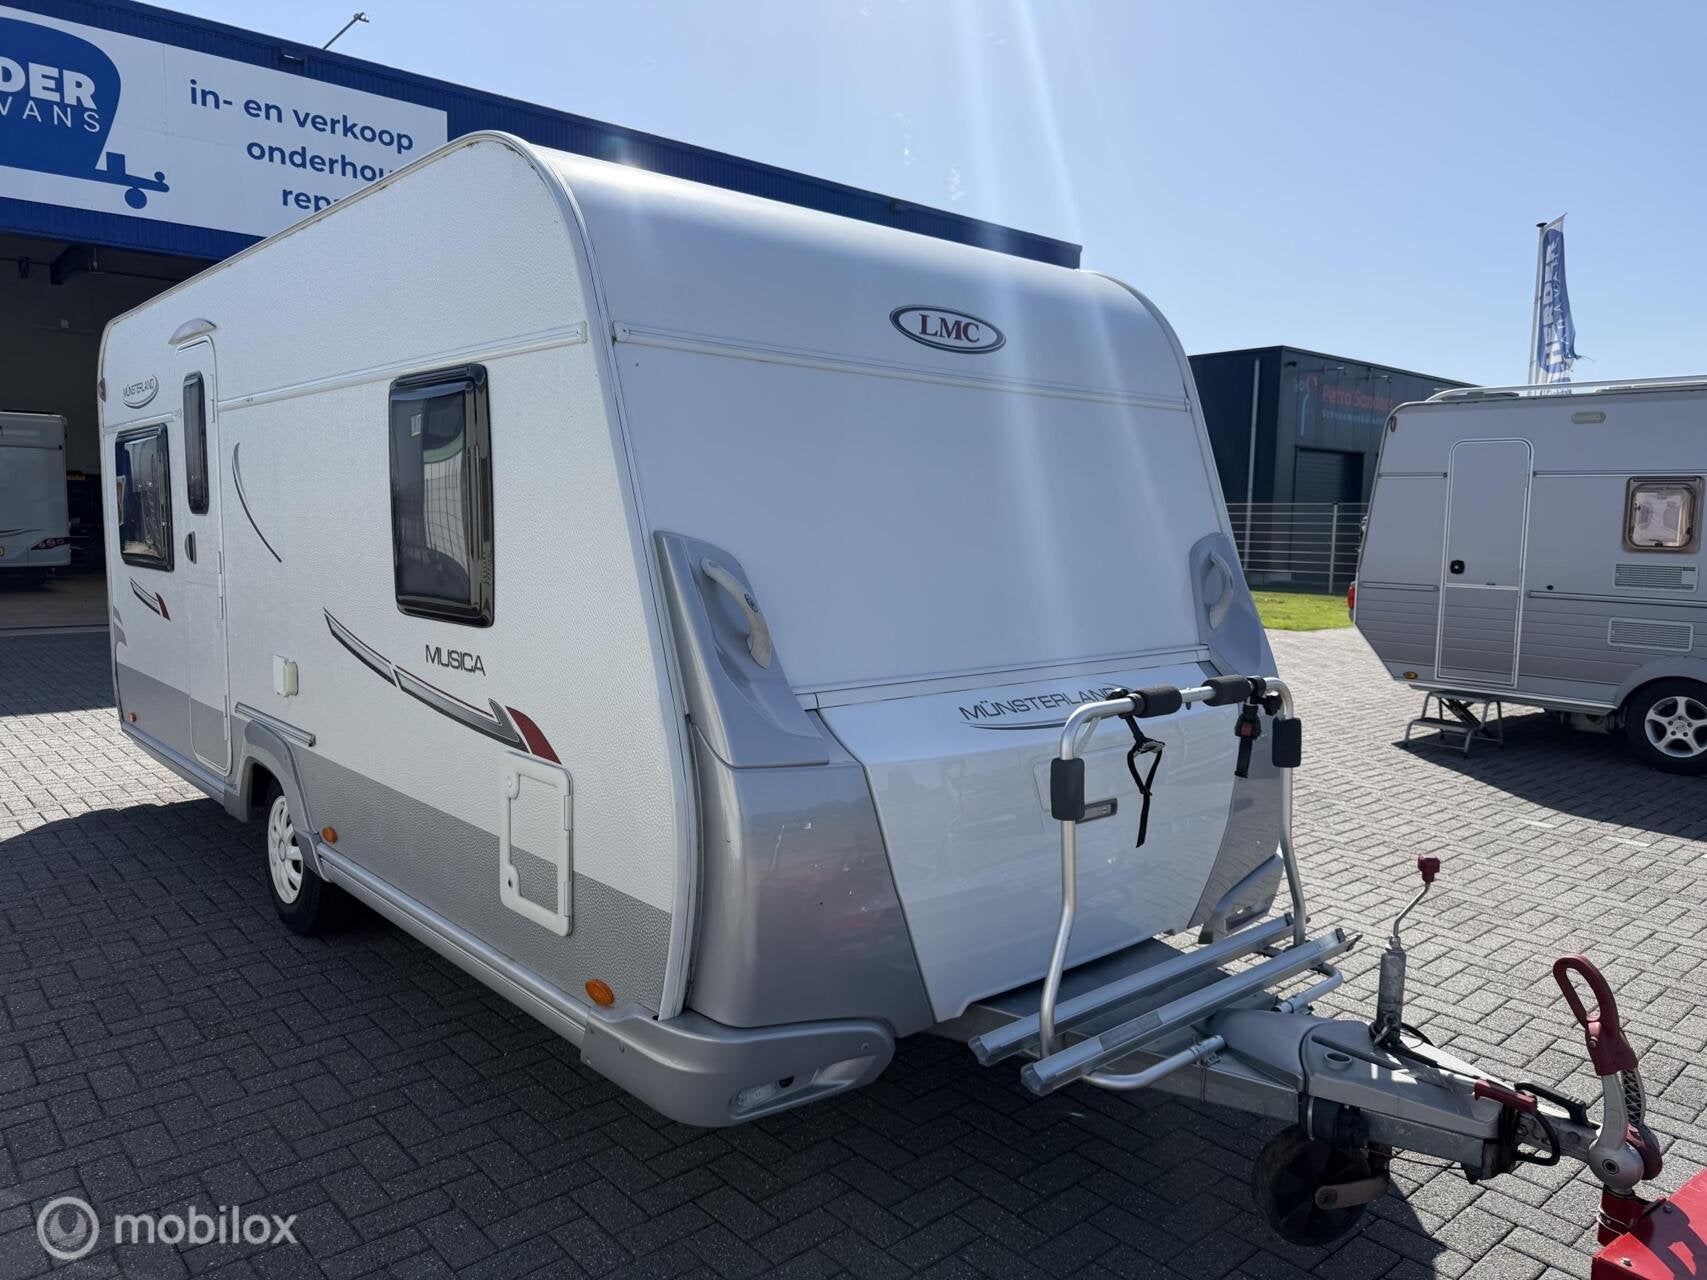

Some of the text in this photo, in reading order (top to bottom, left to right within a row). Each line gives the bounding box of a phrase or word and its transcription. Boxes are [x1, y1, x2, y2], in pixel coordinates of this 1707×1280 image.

[190, 79, 414, 154] in- en verkoop
[282, 188, 340, 214] rep
[918, 313, 981, 343] LMC
[425, 644, 487, 676] MUSICA
